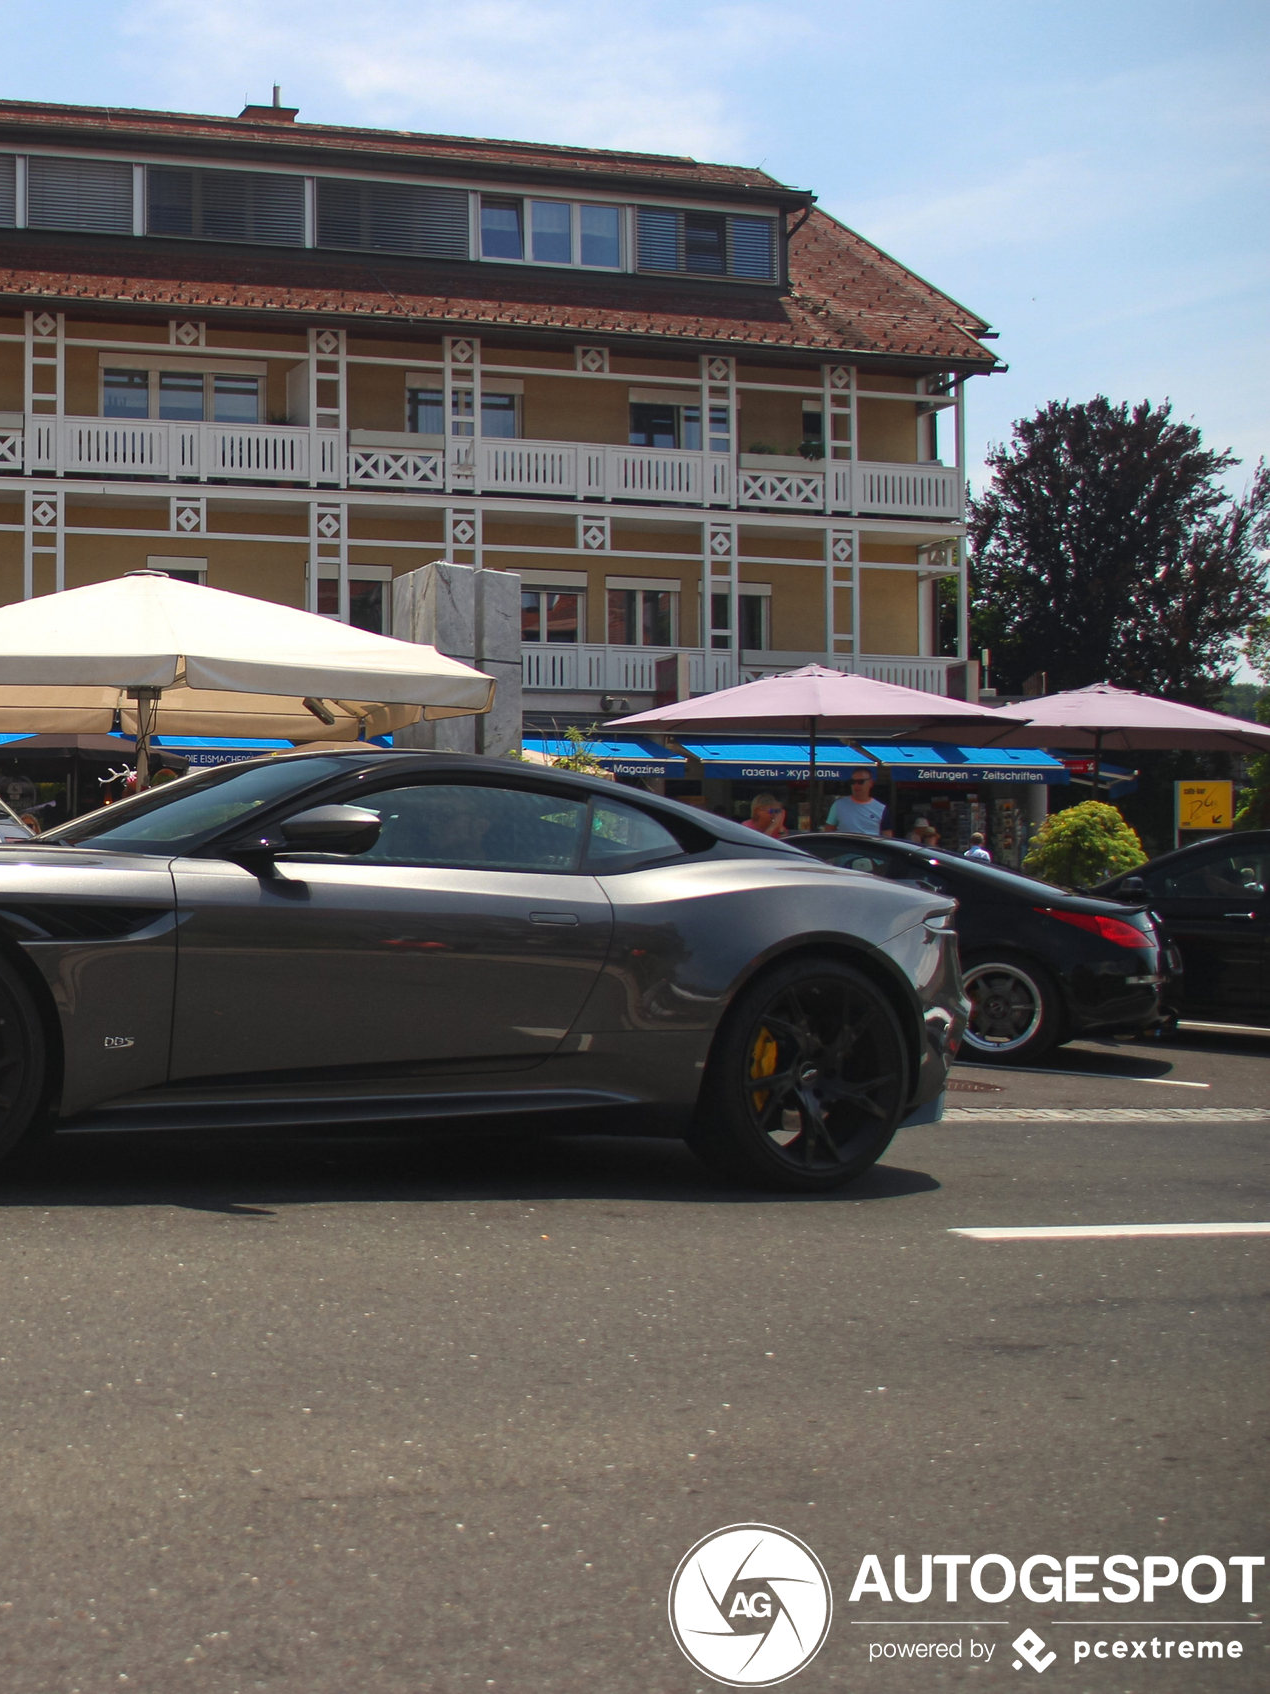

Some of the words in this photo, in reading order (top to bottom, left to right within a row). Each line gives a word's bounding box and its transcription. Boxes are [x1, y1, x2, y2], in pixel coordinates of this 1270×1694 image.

[613, 764, 665, 776] Magazines
[741, 768, 778, 777] газеты
[786, 769, 840, 780] журалы
[917, 769, 969, 781] Zeitungen
[982, 769, 1044, 781] Zeitschriften
